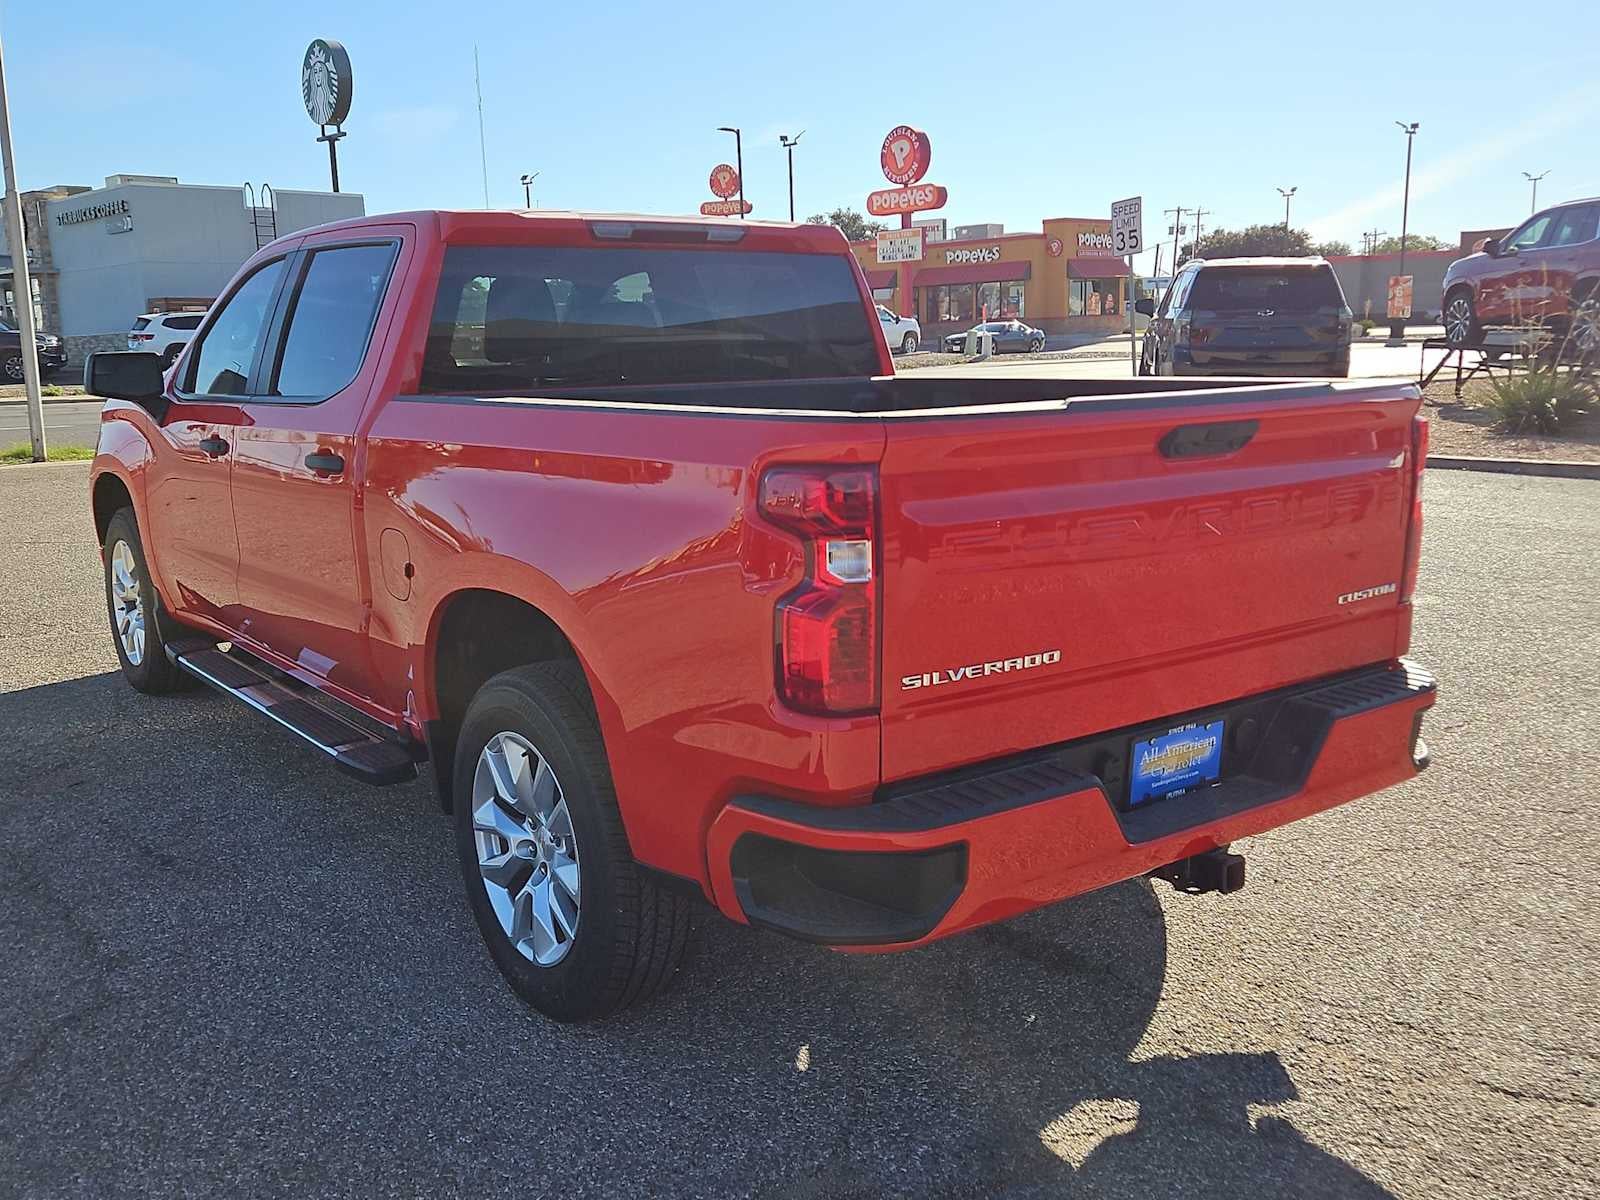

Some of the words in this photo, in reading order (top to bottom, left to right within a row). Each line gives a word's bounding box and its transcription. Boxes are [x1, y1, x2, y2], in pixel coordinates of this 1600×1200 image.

[883, 128, 919, 153] LOUISIANA
[884, 161, 919, 183] KITCHEN
[56, 206, 97, 226] STARBUCKS
[1113, 203, 1140, 218] SPEED
[1116, 216, 1136, 230] LIMIT
[1116, 229, 1139, 252] 35
[1337, 583, 1396, 605] CUSTOM
[901, 650, 1061, 691] SILVERADO
[1140, 746, 1160, 766] All
[1162, 735, 1217, 758] American
